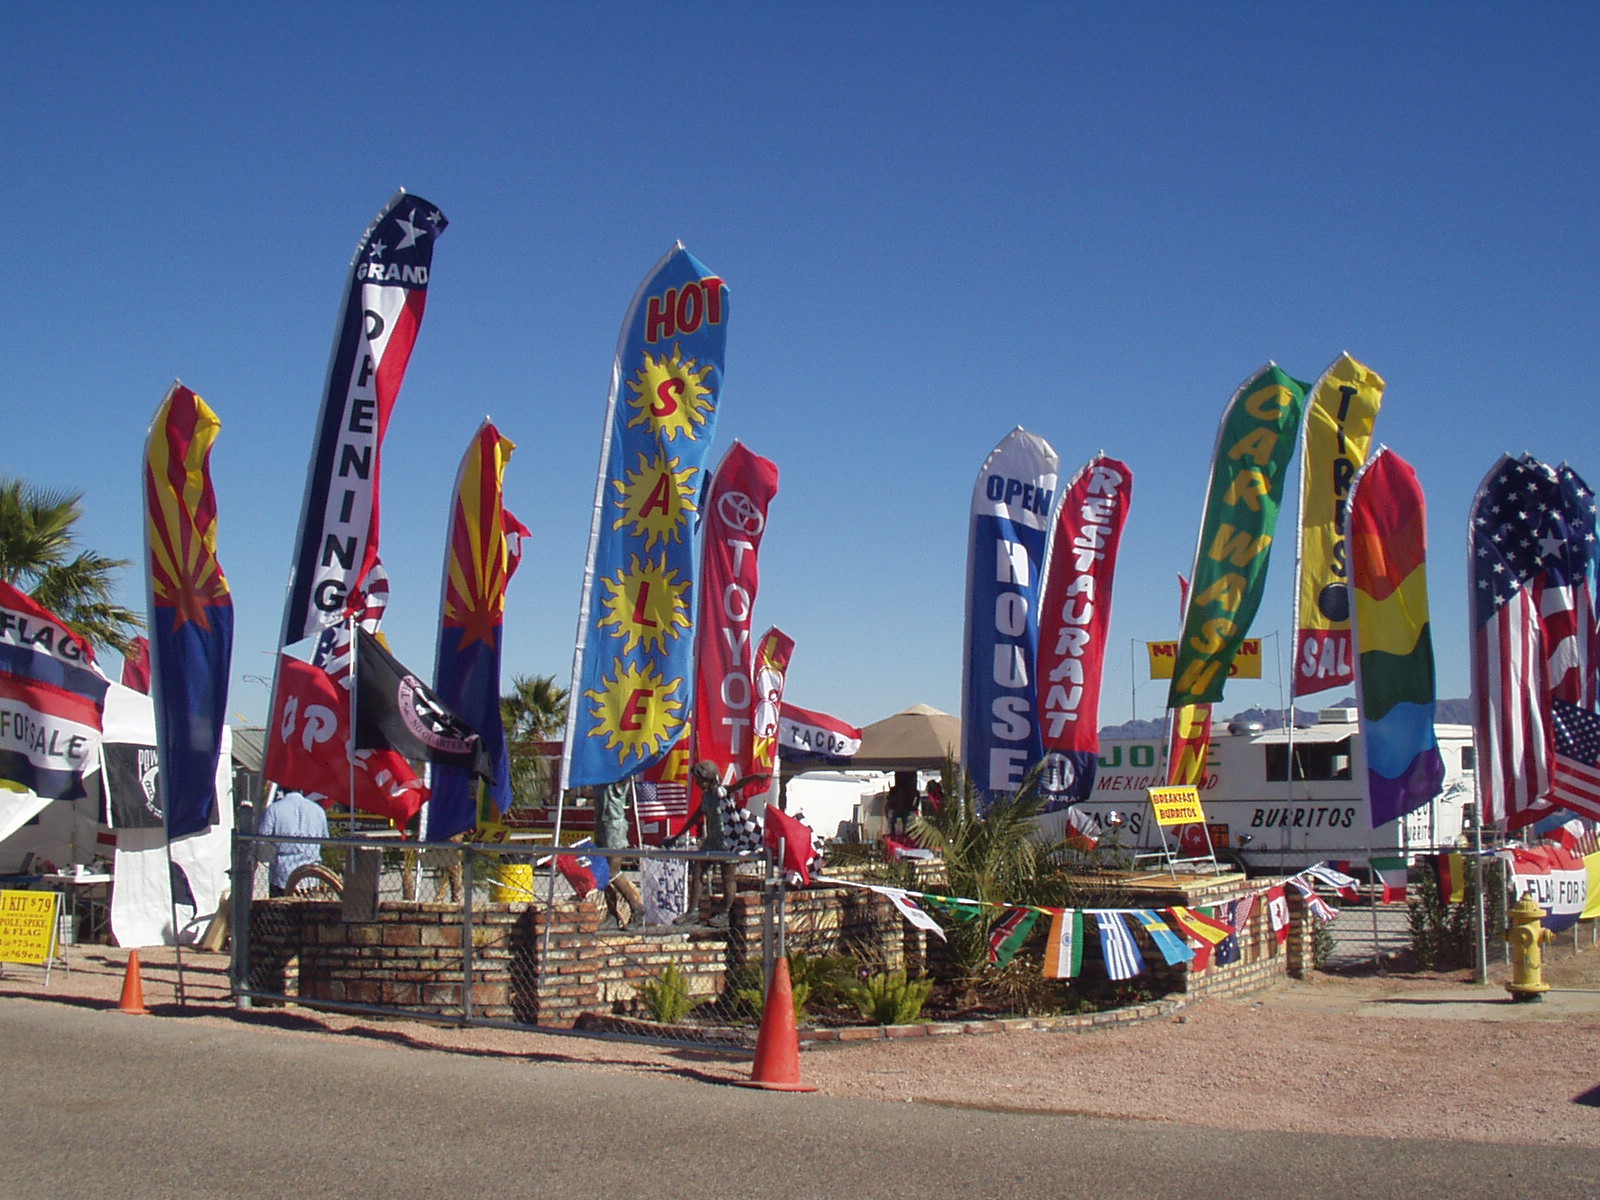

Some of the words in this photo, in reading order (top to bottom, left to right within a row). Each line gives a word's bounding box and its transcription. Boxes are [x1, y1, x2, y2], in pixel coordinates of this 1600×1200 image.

[357, 262, 428, 285] GRAND
[645, 275, 724, 343] HOT
[314, 309, 385, 613] OPENING
[1222, 384, 1291, 512] CAR
[986, 474, 1053, 516] OPEN
[619, 376, 685, 732] SALE
[1045, 466, 1123, 739] RESTAURANT
[1175, 523, 1272, 696] WASH
[989, 538, 1031, 792] HOUSE
[1302, 637, 1351, 681] SAL
[791, 726, 844, 753] TACOS
[1153, 792, 1195, 804] BREAKFAST
[1159, 807, 1197, 819] BURRITOS
[1251, 807, 1355, 828] BURRITOS
[9, 897, 28, 911] KIT
[31, 898, 51, 912] $79
[1560, 881, 1579, 904] FOR
[13, 928, 41, 936] FLAG
